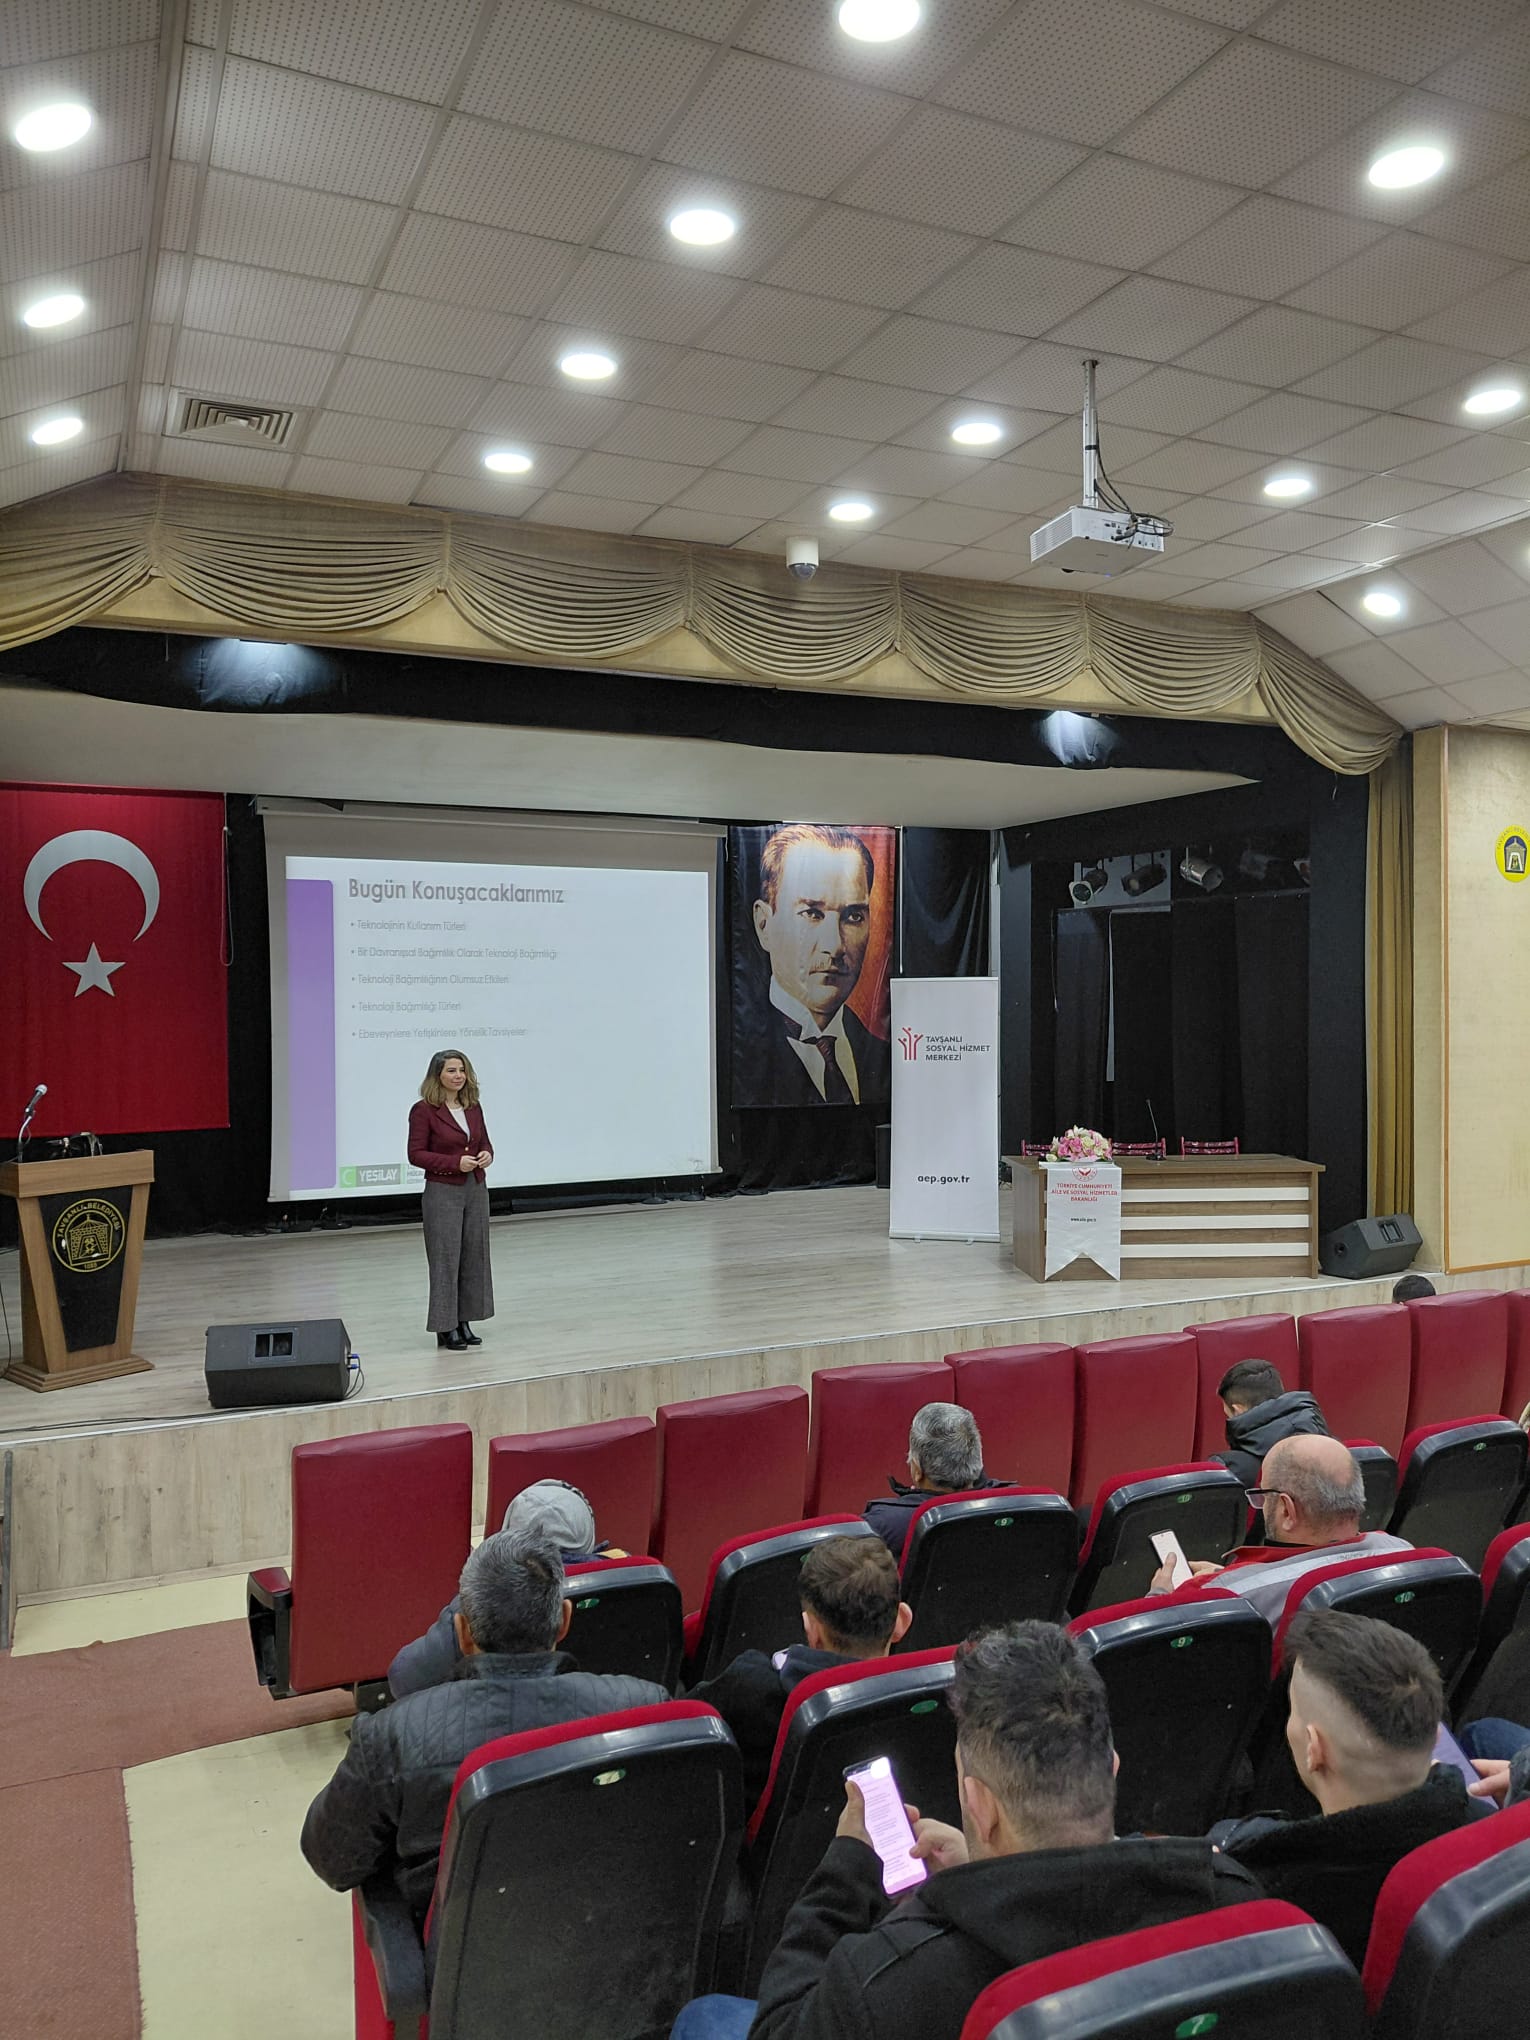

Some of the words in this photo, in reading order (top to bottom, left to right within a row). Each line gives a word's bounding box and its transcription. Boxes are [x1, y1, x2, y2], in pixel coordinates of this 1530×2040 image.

[349, 879, 406, 903] Bugün
[412, 881, 565, 904] Konuşacaklarımız
[357, 920, 405, 932] Teknolojinin
[407, 921, 441, 931] Kullanım
[357, 947, 368, 957] Bir
[456, 948, 484, 958] Olarak
[485, 948, 518, 960] Teknoloji
[358, 974, 394, 986] Teknoloji
[449, 974, 484, 985] Olumsuz
[358, 1001, 395, 1013] Teknoloji
[926, 1036, 963, 1044] TAVŞANLI
[959, 1043, 991, 1052] HİZMET
[925, 1052, 962, 1061] MERKEZİ
[917, 1175, 971, 1185] aep.gov.tr
[1191, 2015, 1206, 2036] 7
